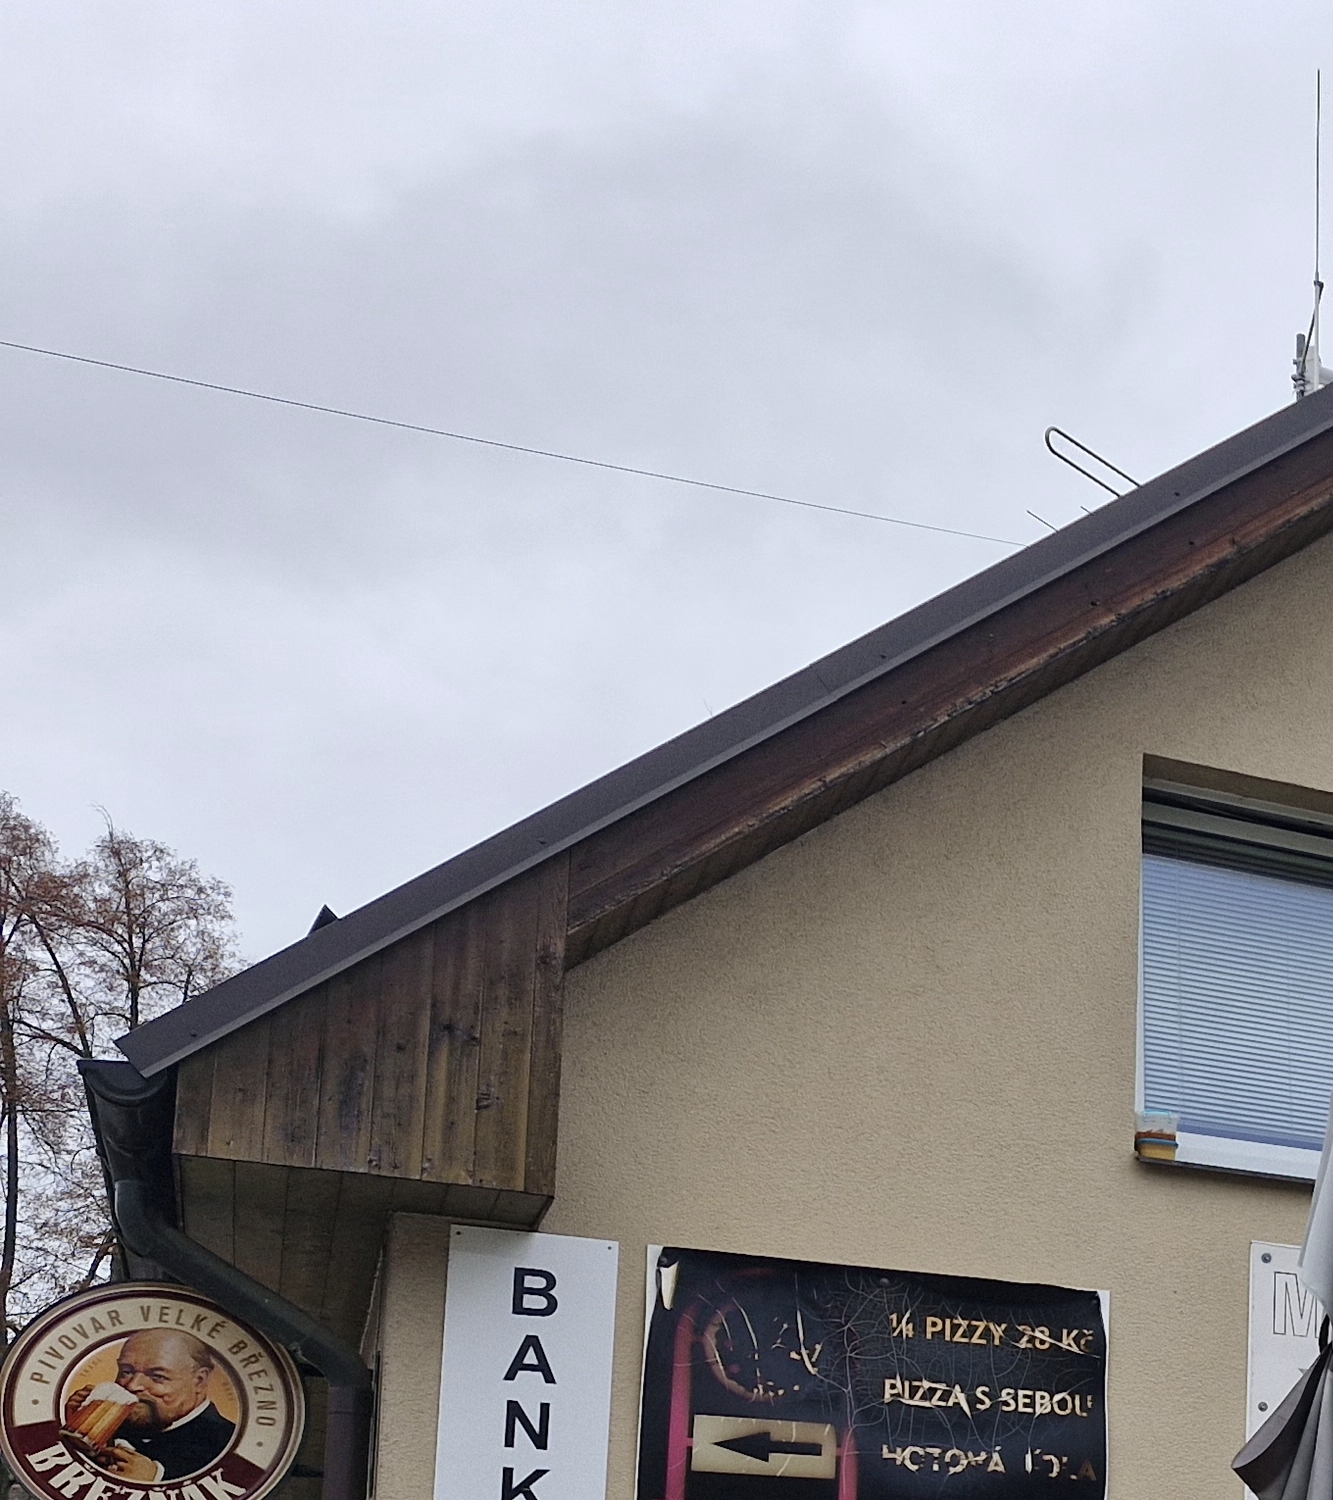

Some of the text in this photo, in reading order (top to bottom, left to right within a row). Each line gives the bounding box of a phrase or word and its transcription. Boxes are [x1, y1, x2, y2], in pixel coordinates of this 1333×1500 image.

[926, 1316, 1007, 1346] PIZZY
[1062, 1327, 1094, 1353] Kč
[30, 1304, 278, 1428] PIVOVAR VELKÉ BŘEZNO
[884, 1377, 1093, 1418] PIZZA S SEBOU
